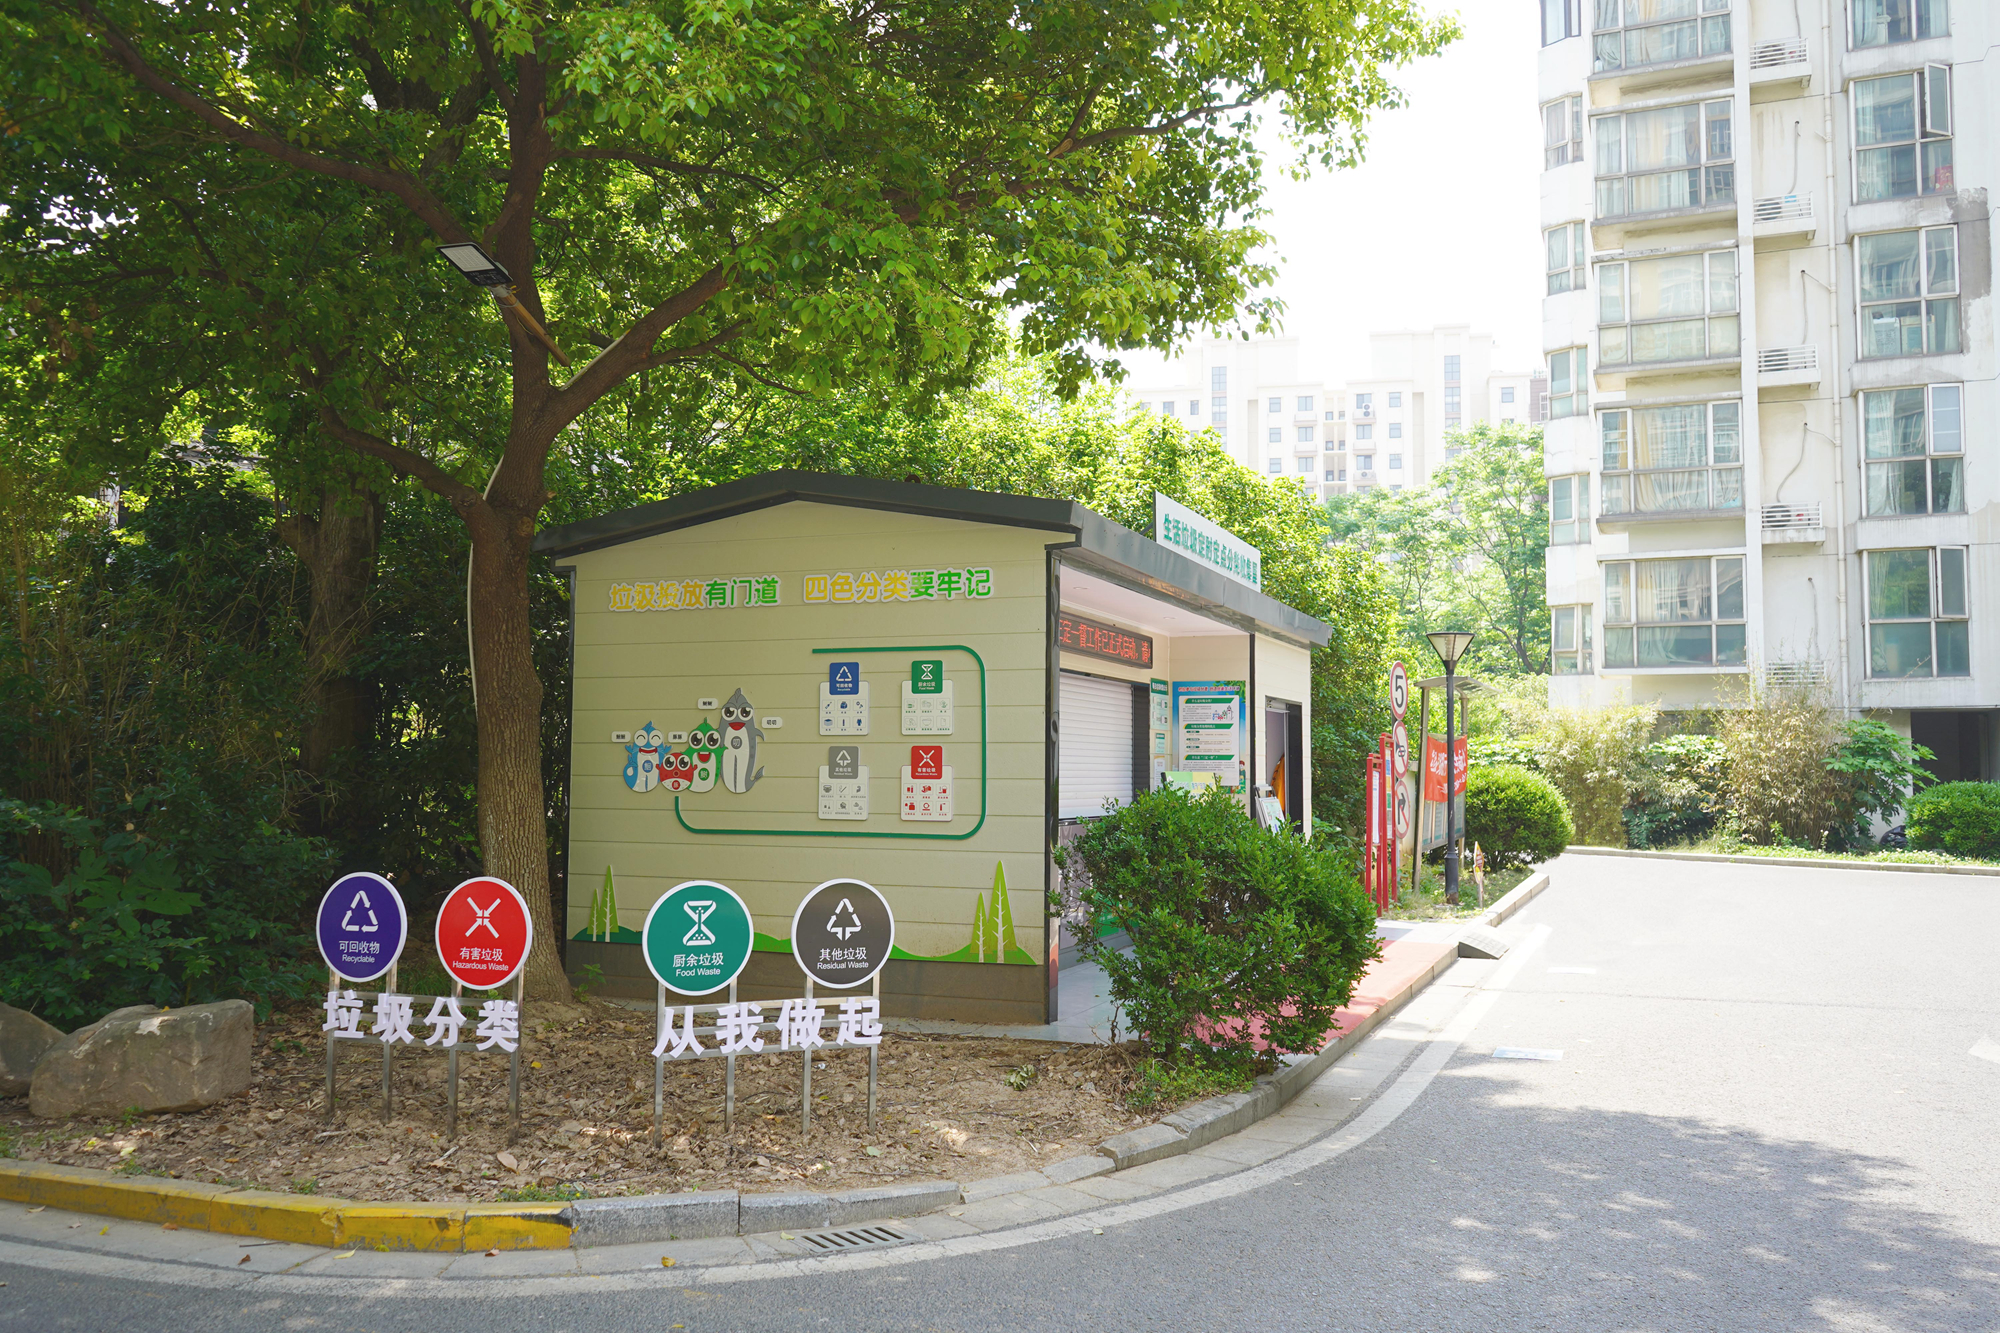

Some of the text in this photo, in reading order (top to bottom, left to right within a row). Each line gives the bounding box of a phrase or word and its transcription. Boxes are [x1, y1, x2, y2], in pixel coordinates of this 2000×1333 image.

[610, 569, 991, 609] 垃圾投放有门道 四色分类要牢记
[1395, 675, 1404, 708] 5
[339, 940, 380, 955] 可回收物
[460, 946, 504, 961] 有害垃圾
[819, 947, 868, 962] 其他垃圾
[342, 954, 376, 965] Recyclable
[452, 960, 509, 972] Hazardous Waste
[672, 953, 724, 968] 厨余垃圾
[817, 960, 869, 970] Residual Waste
[676, 966, 722, 978] Food Waste
[322, 990, 520, 1053] 垃圾分类
[652, 997, 884, 1058] 从我做起
